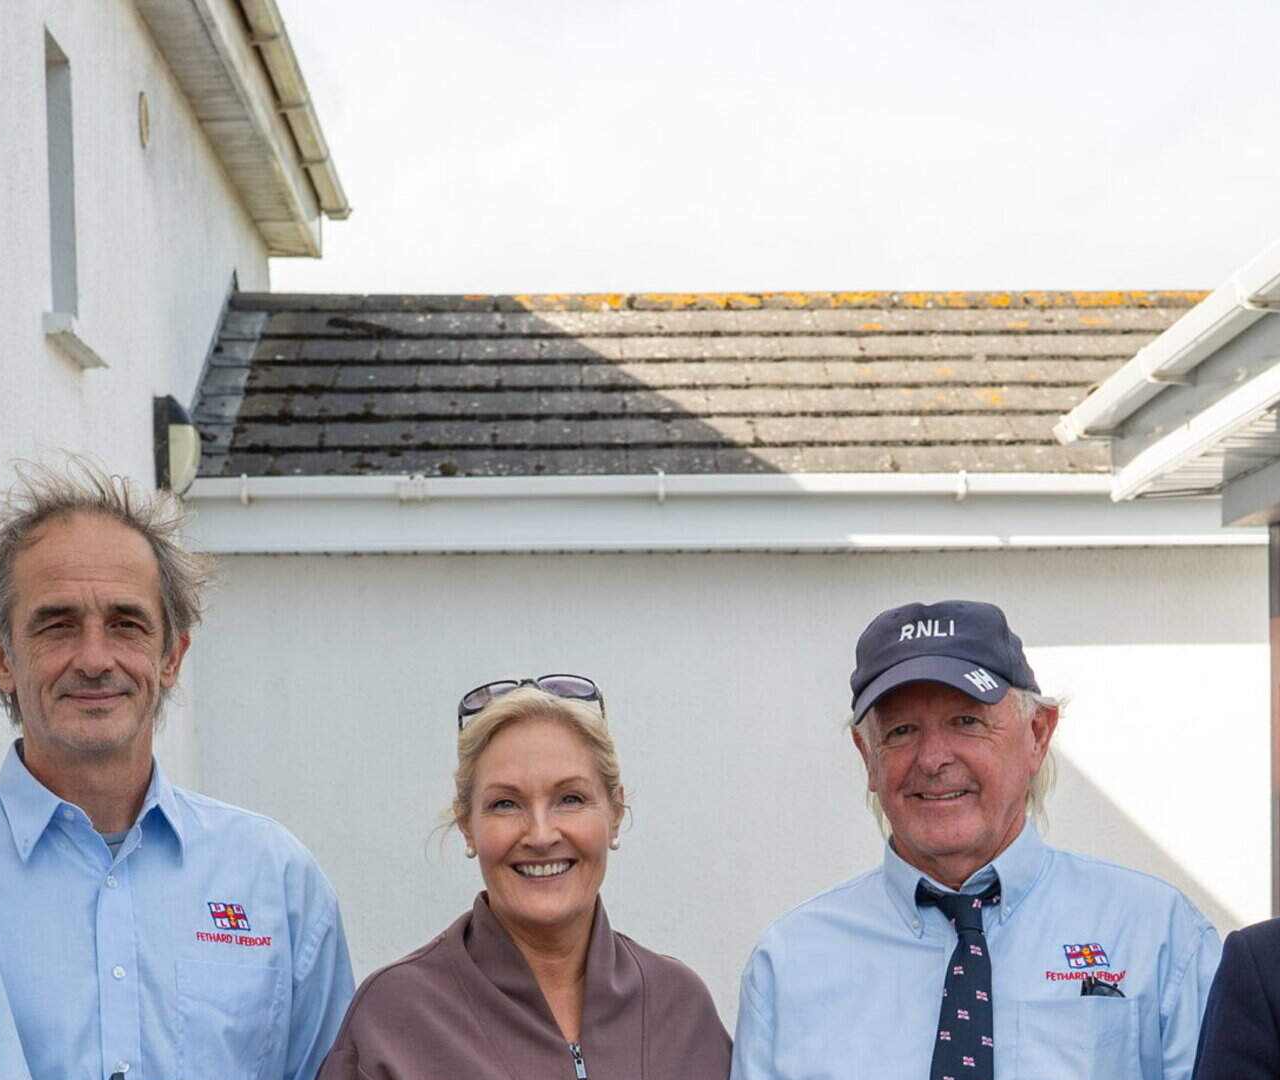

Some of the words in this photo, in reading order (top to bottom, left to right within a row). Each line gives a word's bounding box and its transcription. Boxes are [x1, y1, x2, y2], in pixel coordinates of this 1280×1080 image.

[899, 619, 955, 642] RNLI
[196, 931, 233, 944] FETHARD
[235, 935, 272, 947] LIFEBOAT
[1046, 970, 1089, 981] FETHARD
